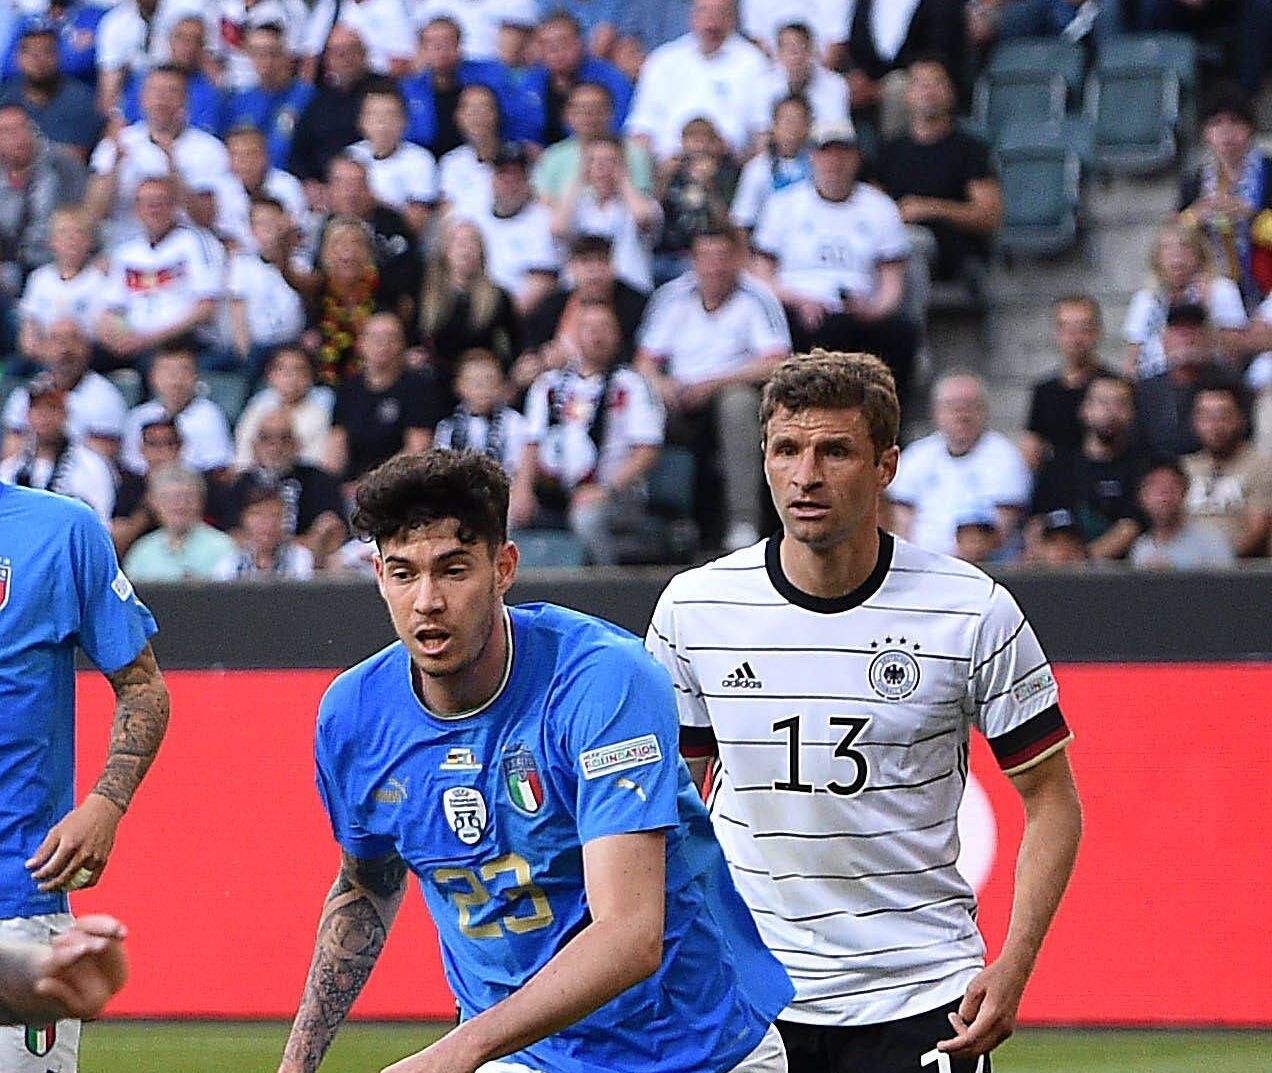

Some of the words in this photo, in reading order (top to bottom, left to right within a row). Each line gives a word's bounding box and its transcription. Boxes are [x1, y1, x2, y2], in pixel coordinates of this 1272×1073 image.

[721, 677, 763, 690] adidas
[584, 742, 659, 770] FOUNDATION
[770, 714, 871, 797] 13
[434, 852, 554, 941] 23
